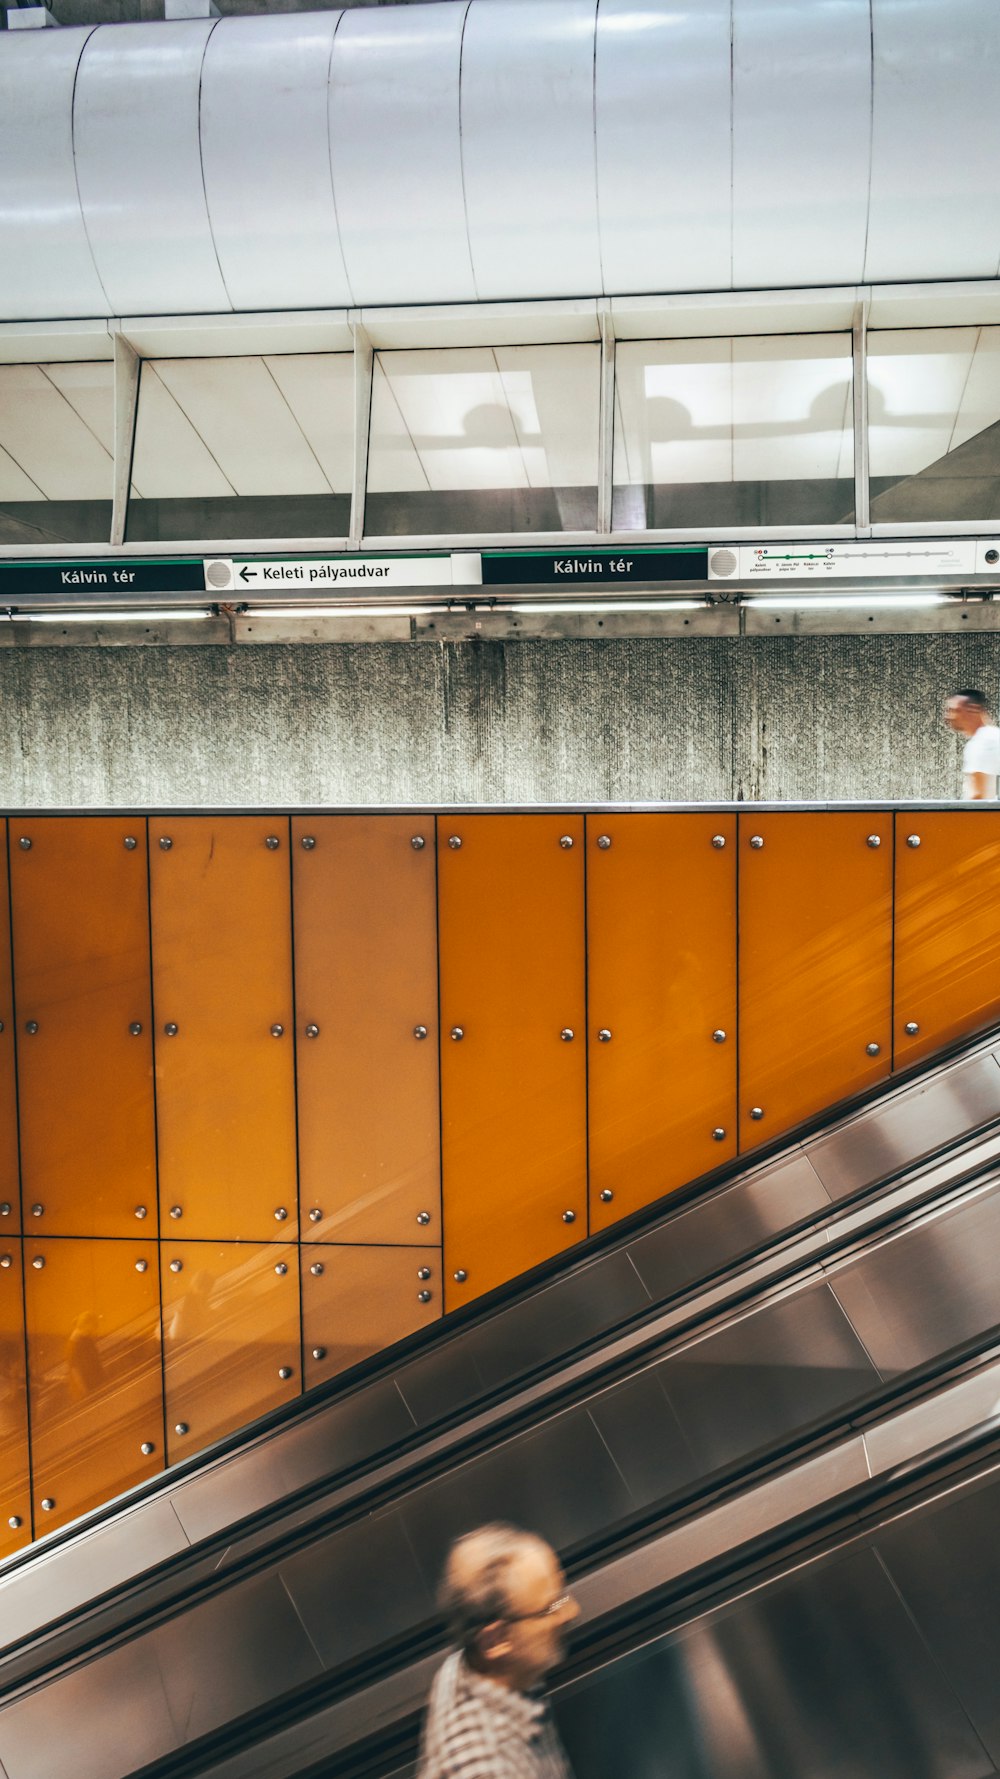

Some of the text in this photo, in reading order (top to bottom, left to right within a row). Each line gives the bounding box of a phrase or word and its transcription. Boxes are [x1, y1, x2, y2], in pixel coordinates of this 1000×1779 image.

[263, 565, 390, 581] Keleti pályaudvar
[553, 559, 634, 574] Kálvin tér
[60, 569, 136, 585] Kálvin tér
